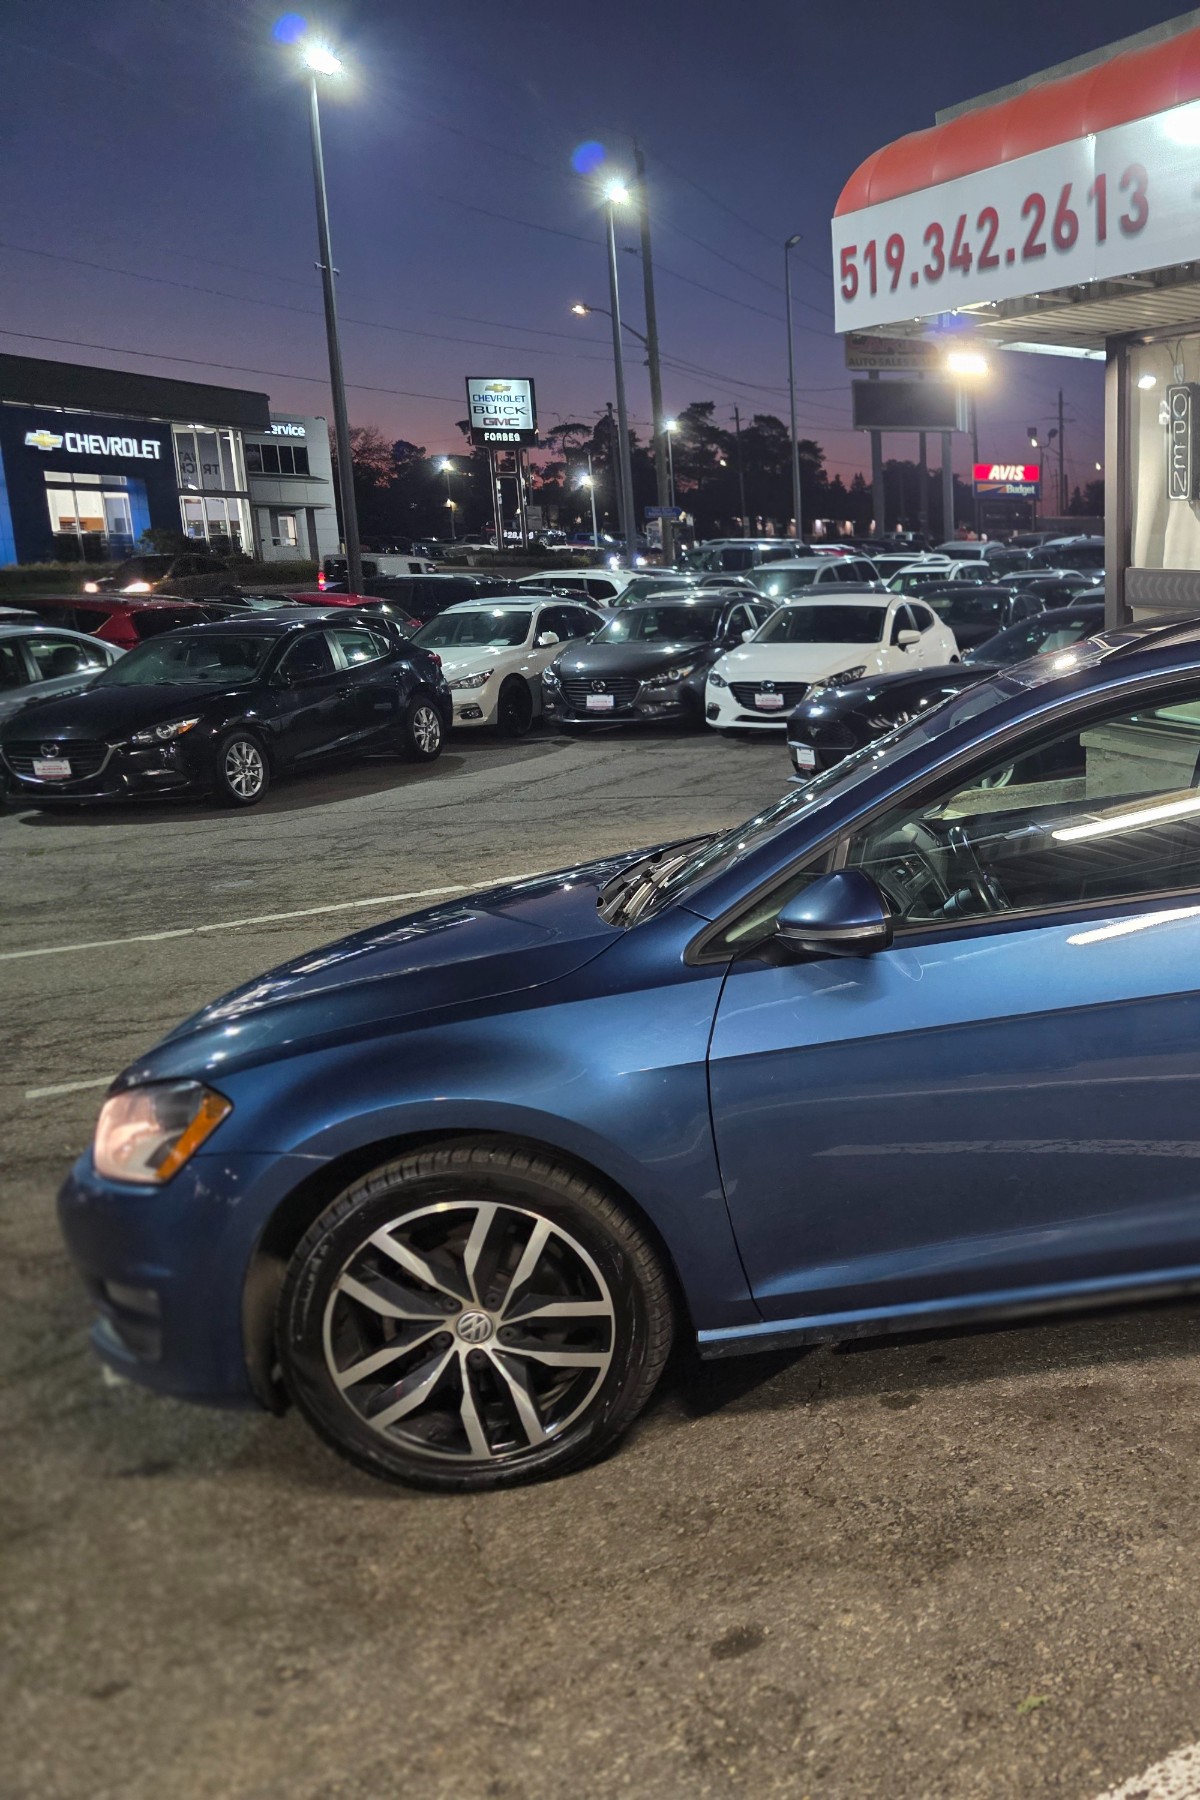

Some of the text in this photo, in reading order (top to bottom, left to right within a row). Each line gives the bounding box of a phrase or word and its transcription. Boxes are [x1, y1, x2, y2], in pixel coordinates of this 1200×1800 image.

[840, 163, 1150, 301] 519.342.2613
[473, 394, 526, 403] CHEVROLET
[473, 405, 527, 415] BUICK
[483, 417, 520, 426] GMC
[265, 423, 306, 437] ervice
[484, 432, 521, 441] FORBES
[65, 432, 161, 460] CHEVROLET
[1172, 393, 1188, 493] OPEN
[988, 464, 1025, 480] AVIS
[1006, 484, 1035, 496] Budget
